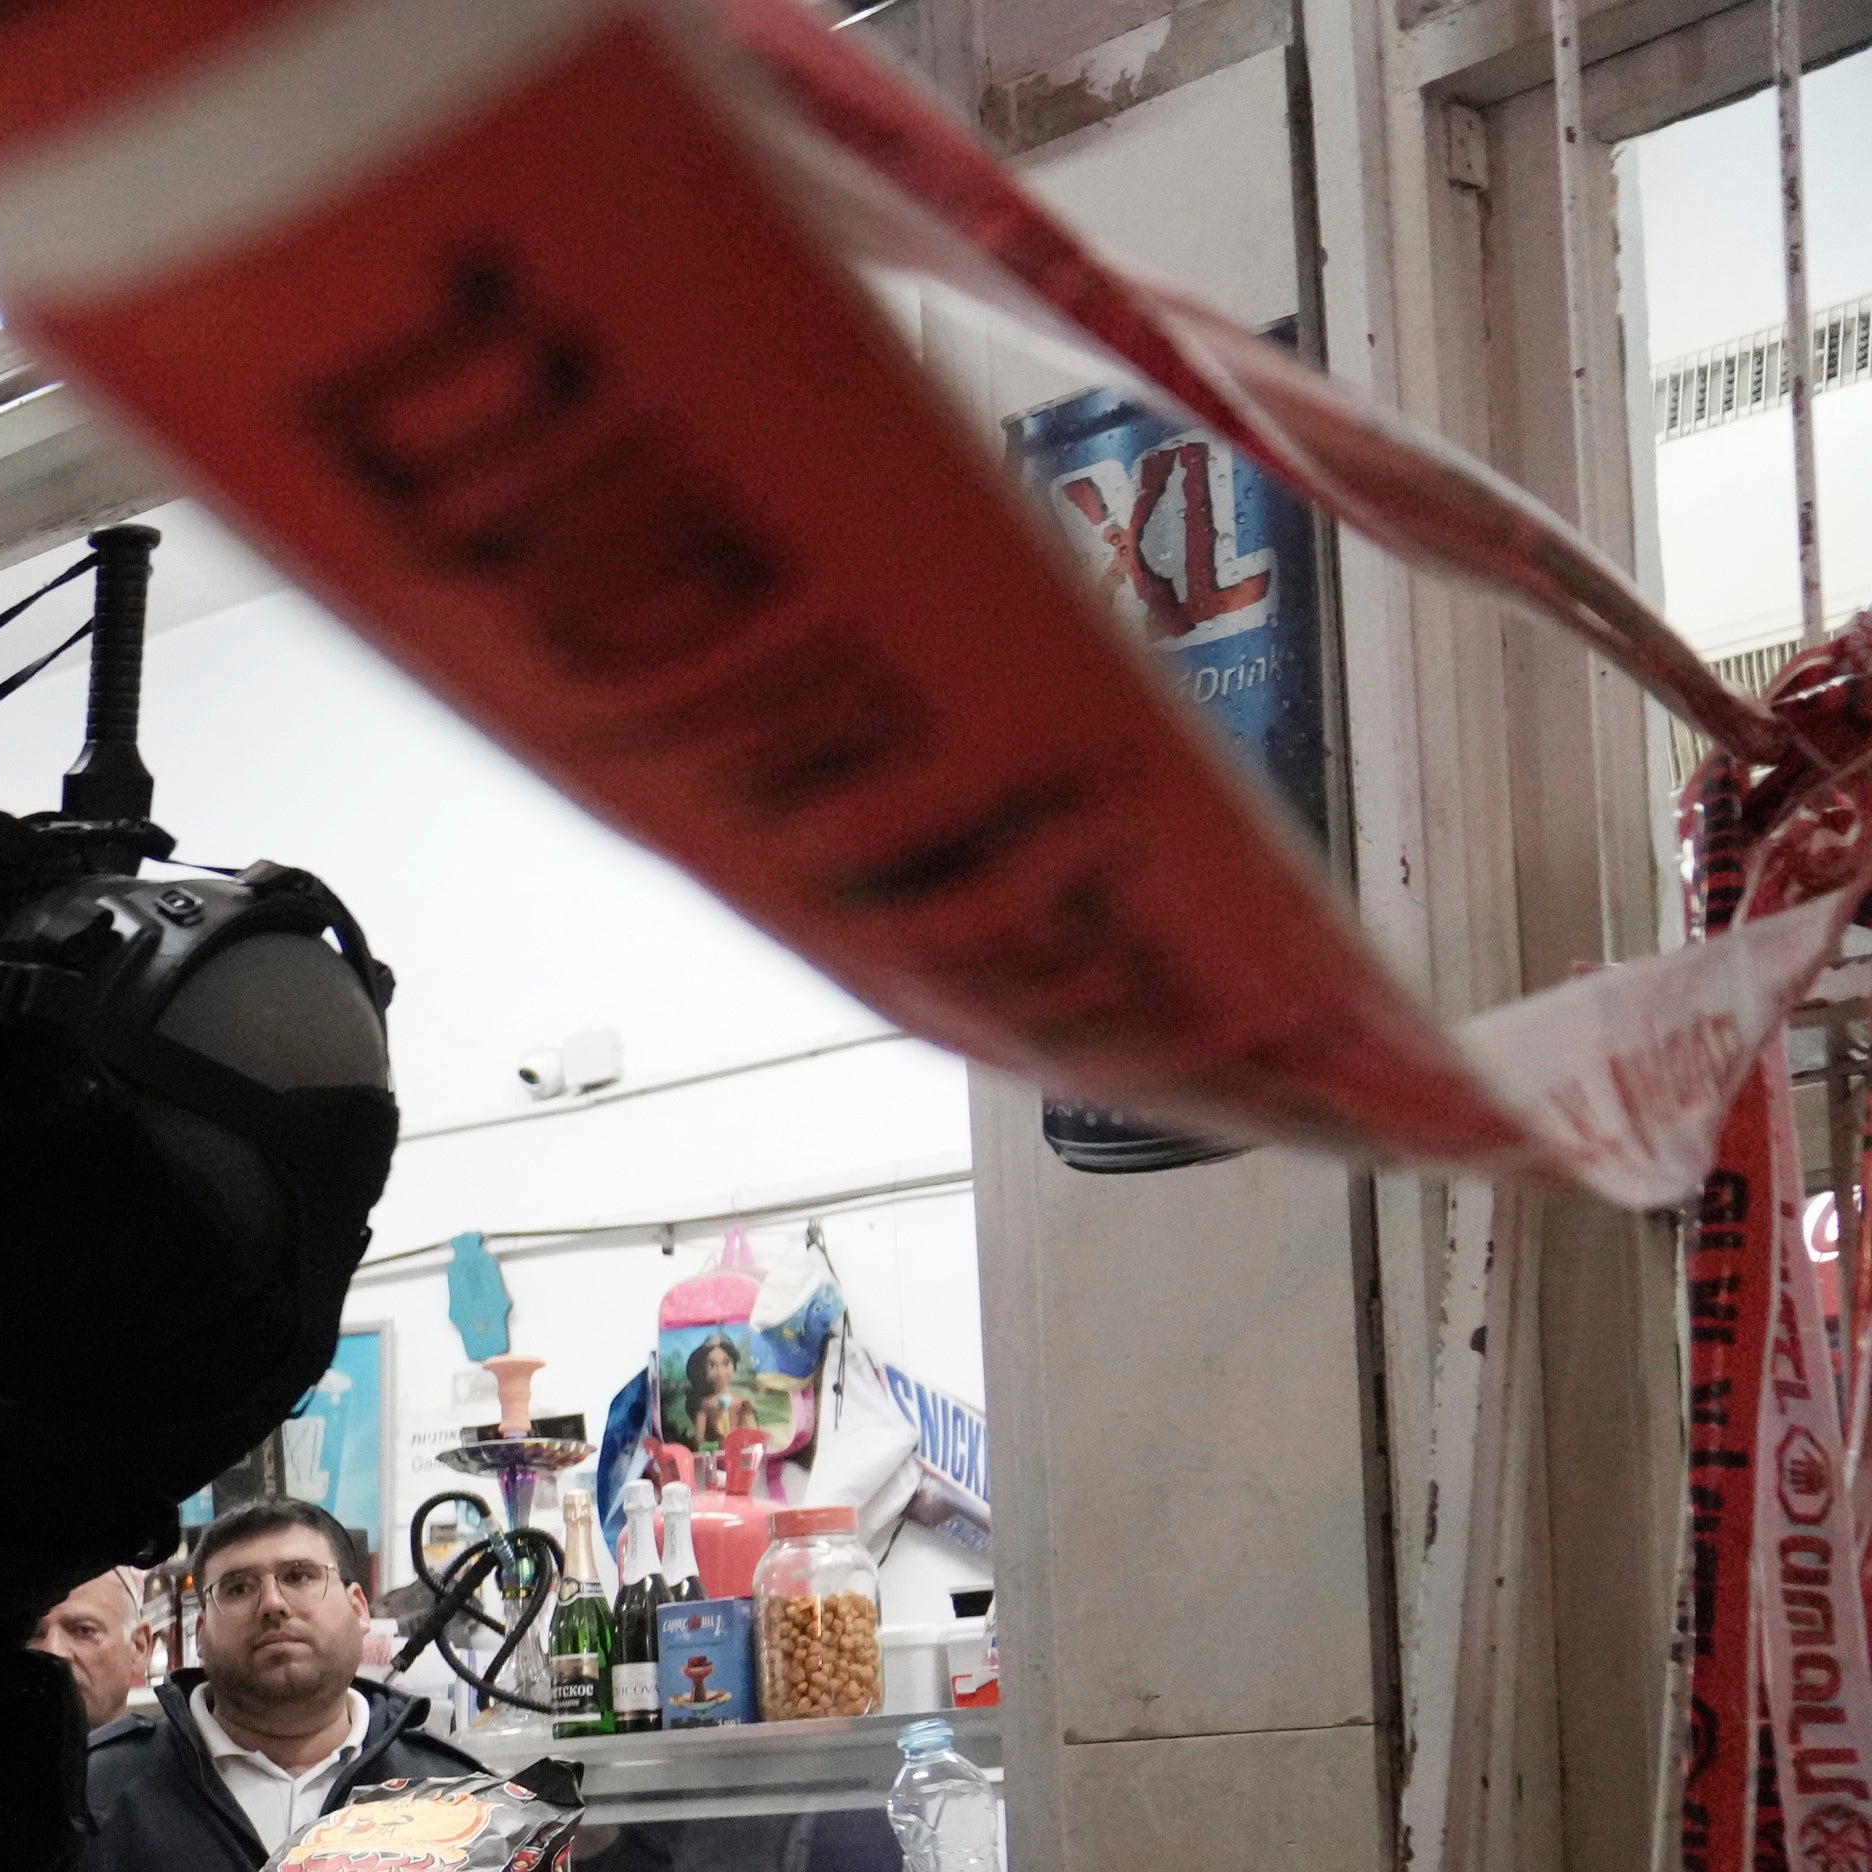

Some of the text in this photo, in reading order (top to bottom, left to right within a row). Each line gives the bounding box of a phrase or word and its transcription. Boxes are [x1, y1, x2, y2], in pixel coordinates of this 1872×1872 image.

[1052, 428, 1277, 648] XL
[883, 1363, 991, 1502] SNICK
[1776, 1533, 1868, 1797] משטרת
